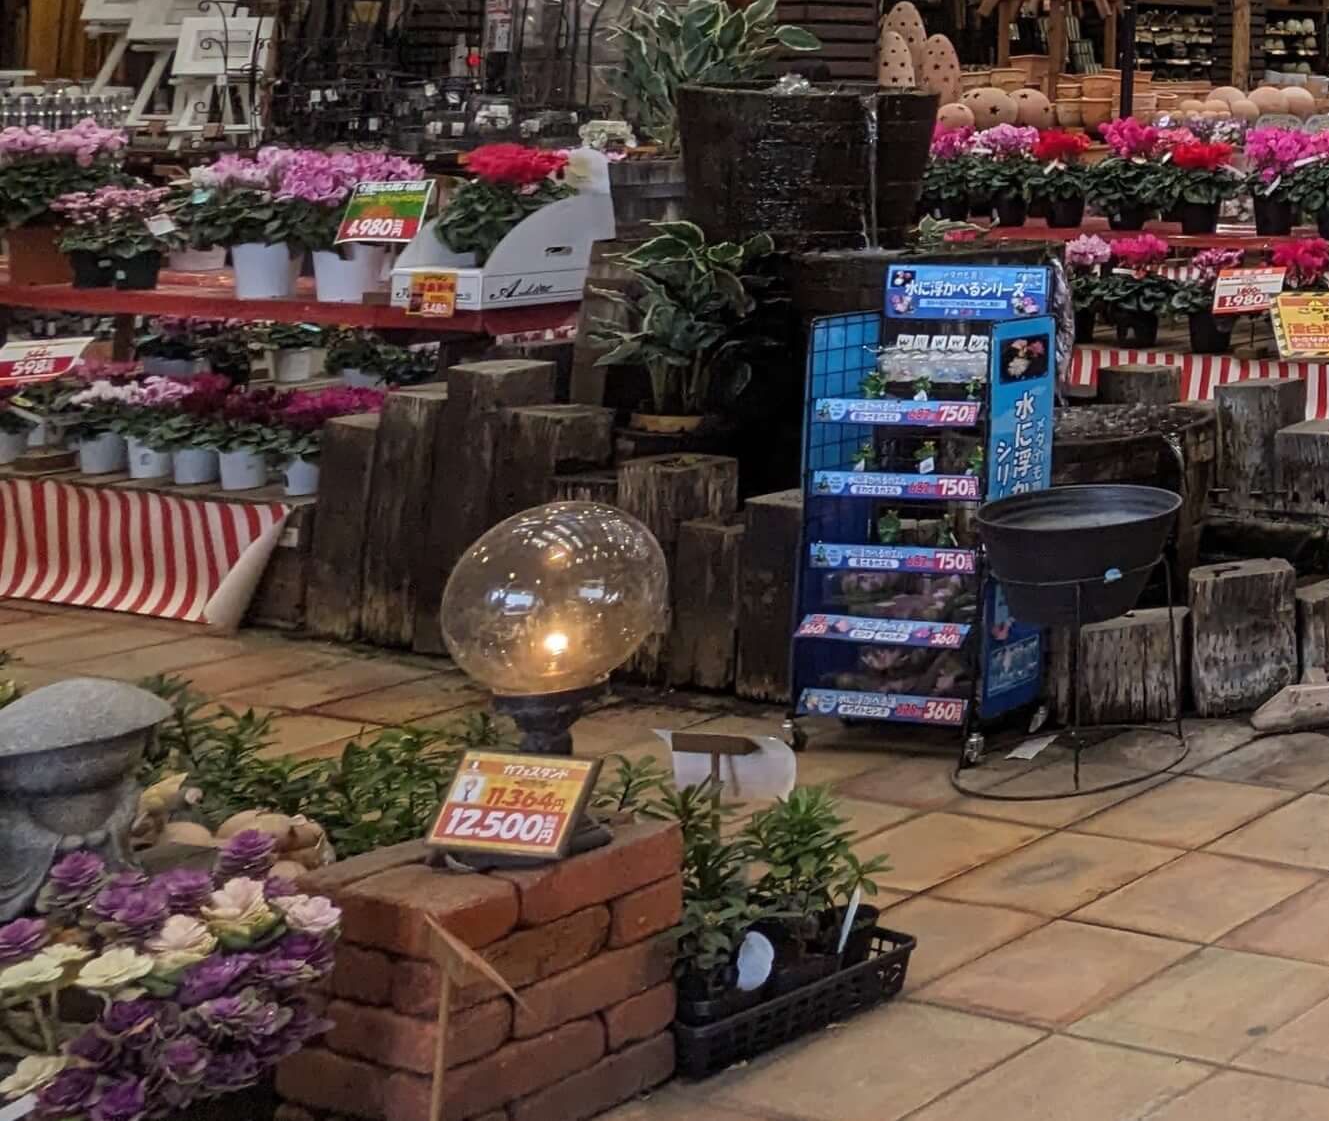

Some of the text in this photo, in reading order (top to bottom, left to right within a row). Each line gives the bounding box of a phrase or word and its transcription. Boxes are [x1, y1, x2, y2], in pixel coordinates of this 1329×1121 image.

[905, 281, 1024, 296] 水に浮かべるシリーズ
